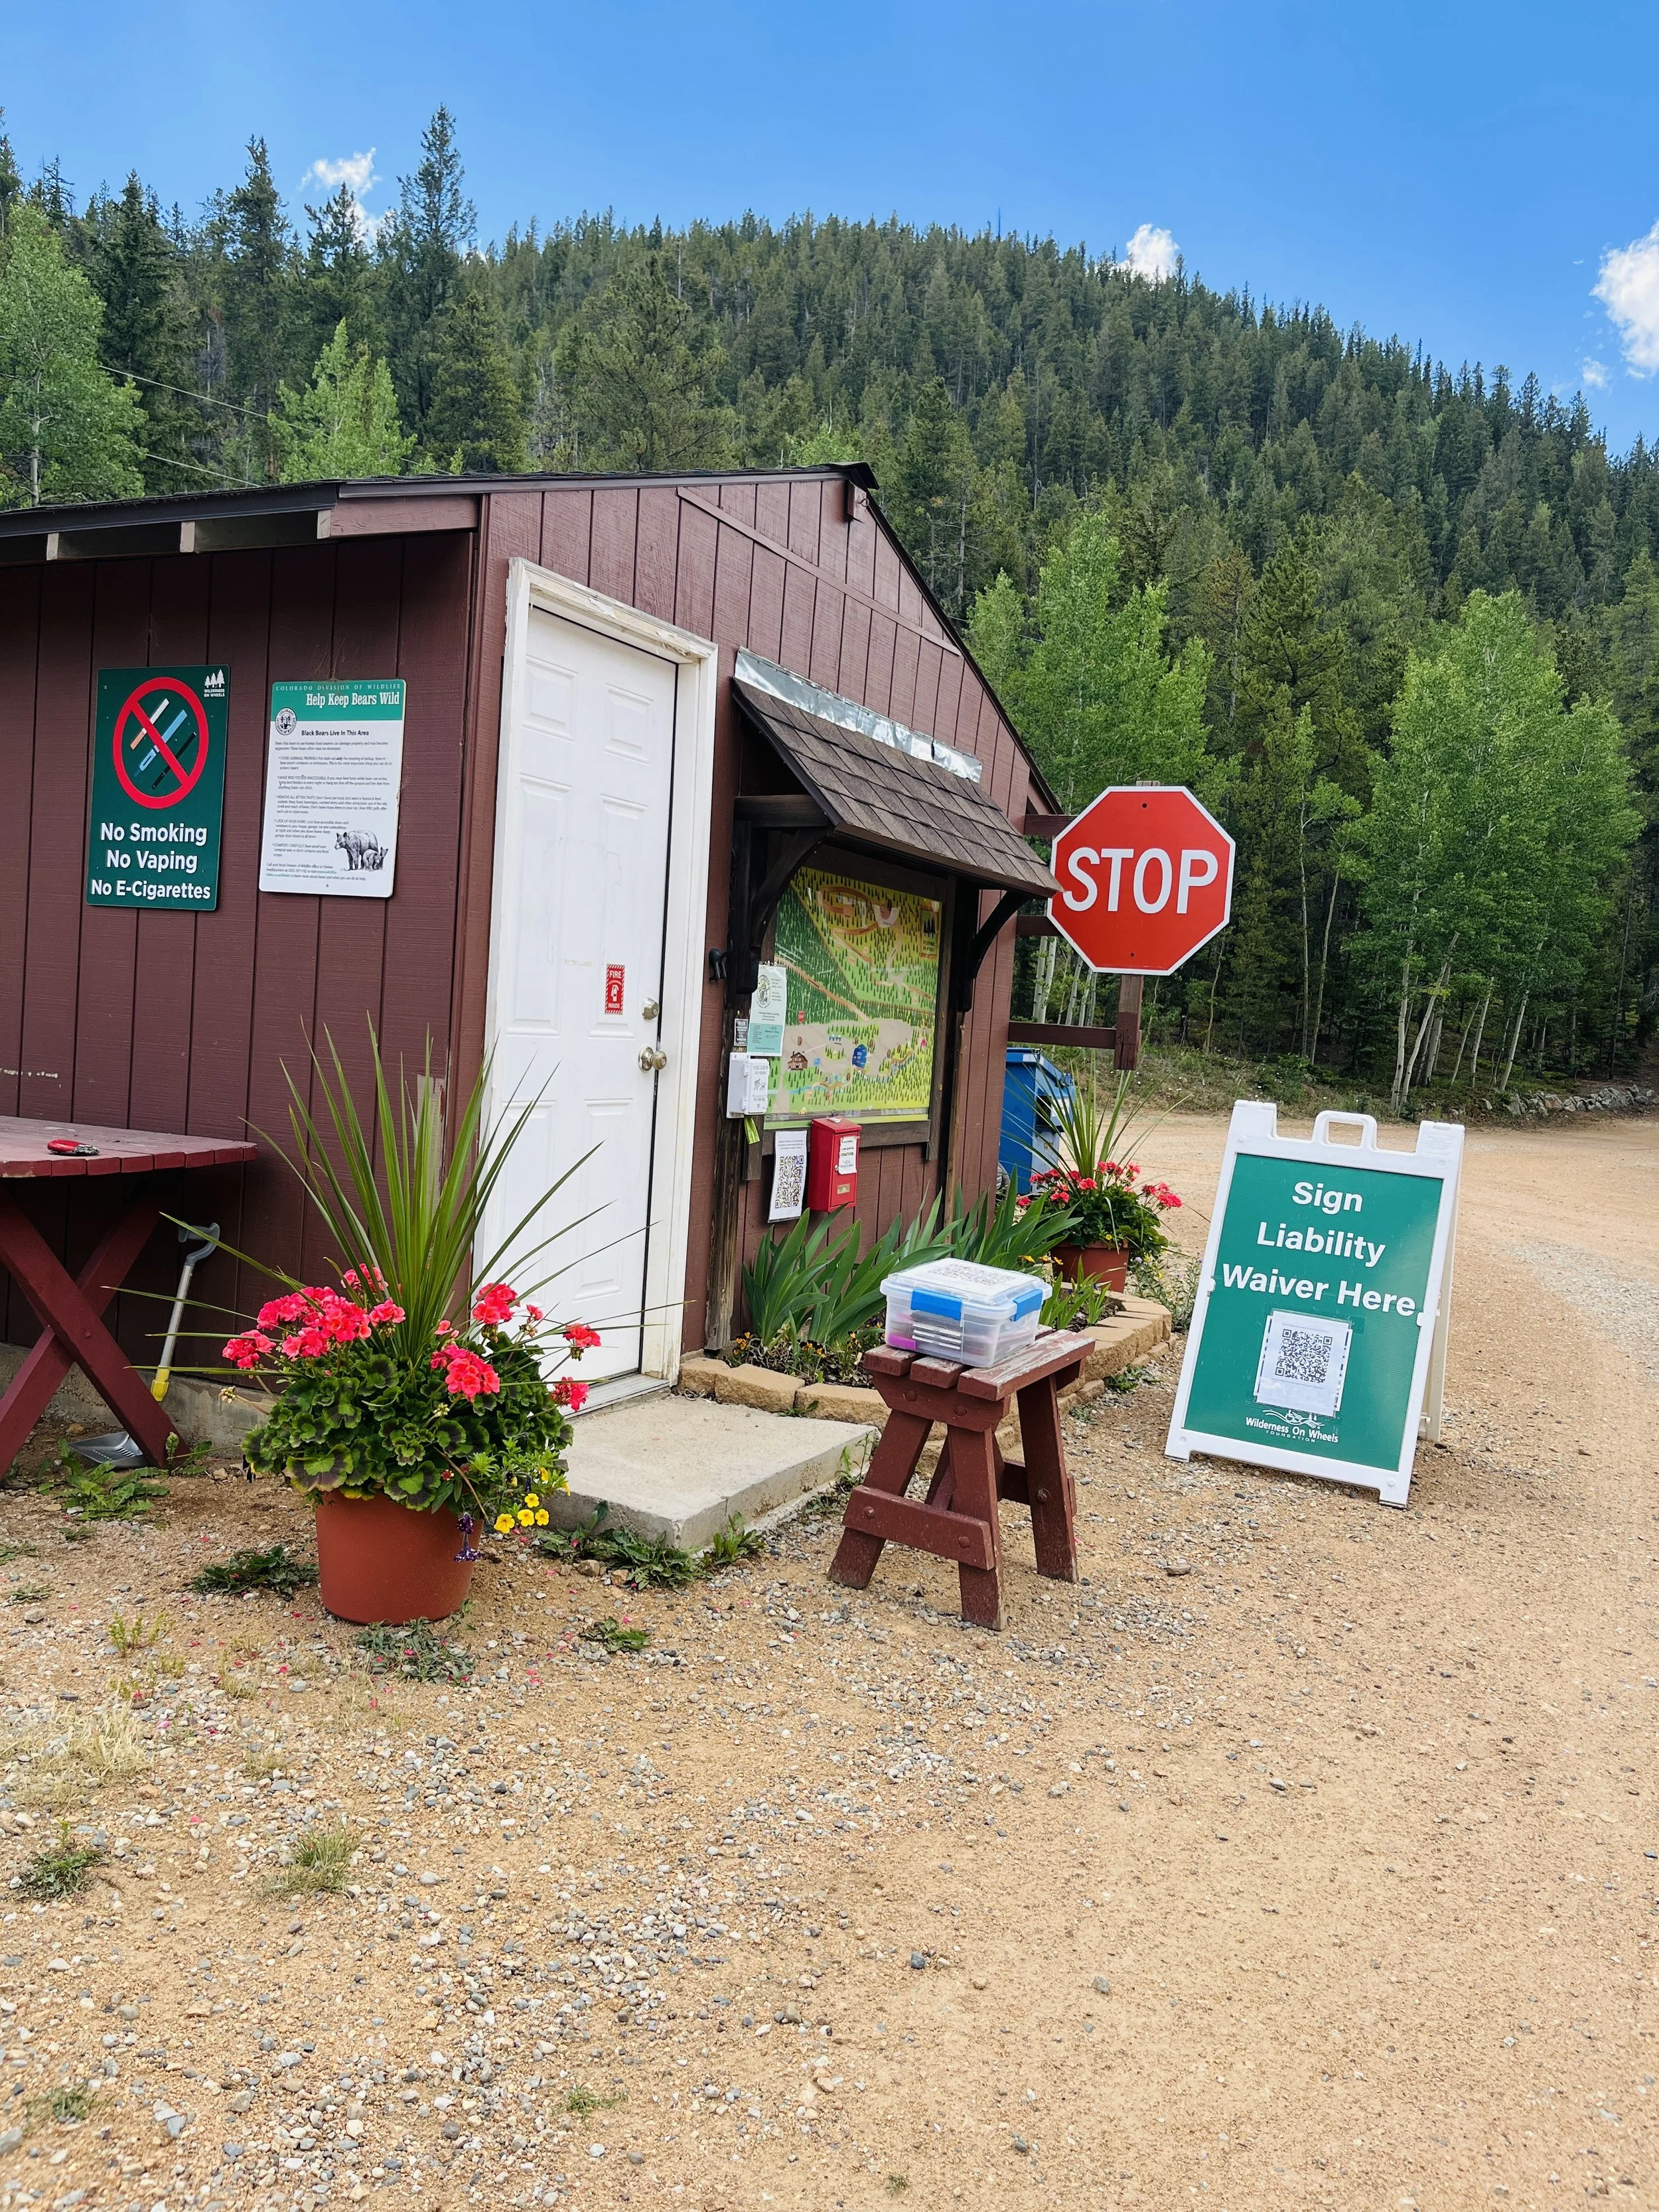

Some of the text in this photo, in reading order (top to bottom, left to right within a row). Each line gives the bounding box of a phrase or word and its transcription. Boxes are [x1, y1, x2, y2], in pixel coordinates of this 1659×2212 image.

[306, 692, 399, 708] Help Keep Bears Wild
[101, 822, 207, 846] No Smoking
[107, 849, 198, 874] No Vaping
[91, 879, 211, 901] No E-Cigarettes
[1062, 847, 1218, 914] STOP
[609, 970, 622, 979] FIRE
[1292, 1181, 1363, 1215] Sign
[1256, 1222, 1387, 1268] Liability
[1222, 1263, 1417, 1317] Waiver Here
[1246, 1417, 1339, 1443] Wilderness On Wheels
[1265, 1430, 1316, 1443] FOUNDATION
